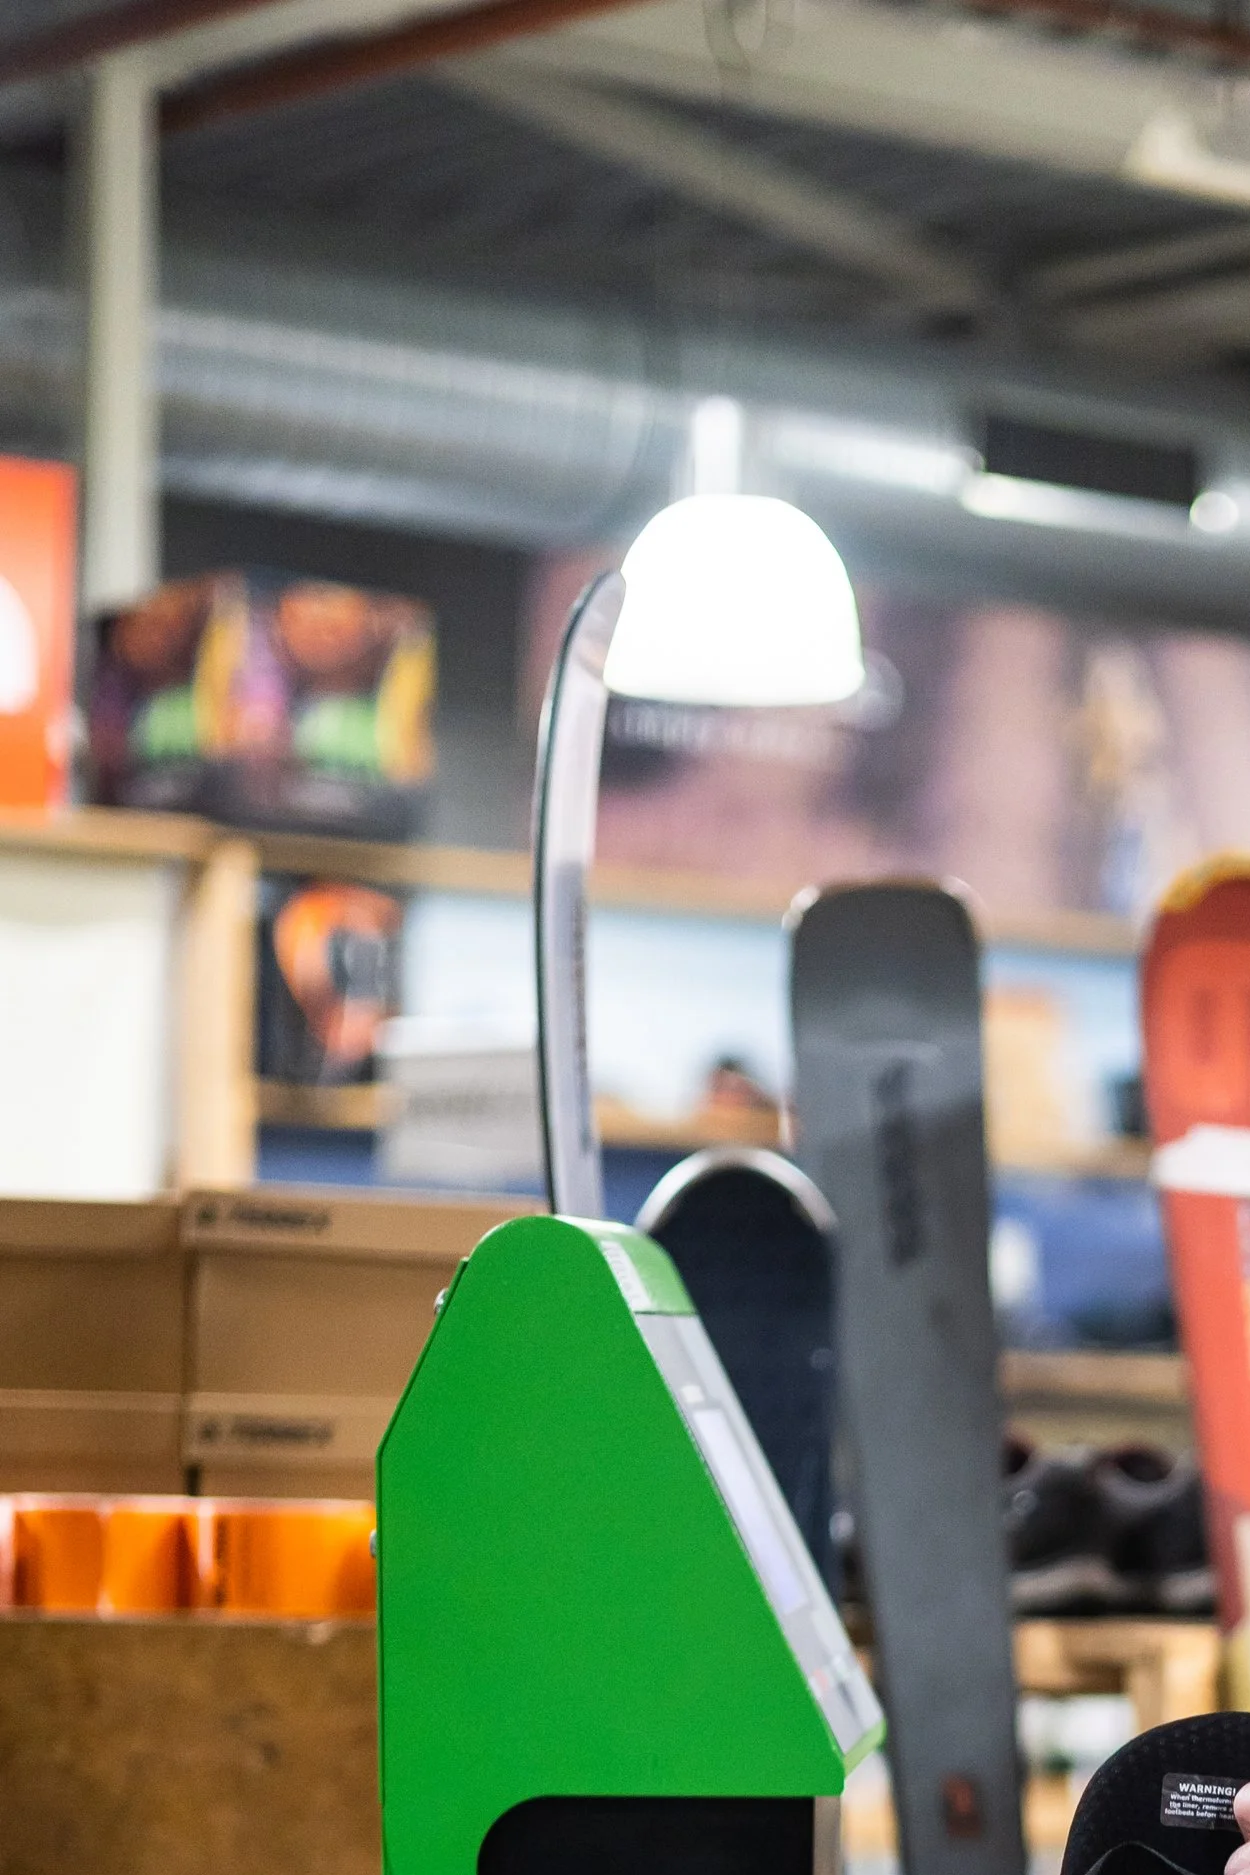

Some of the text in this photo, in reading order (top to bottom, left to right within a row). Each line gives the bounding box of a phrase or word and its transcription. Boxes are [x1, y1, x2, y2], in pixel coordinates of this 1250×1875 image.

[1179, 1783, 1236, 1796] WARNING!
[1170, 1793, 1190, 1801] When
[1169, 1801, 1181, 1809] the
[1164, 1808, 1194, 1817] footbeds
